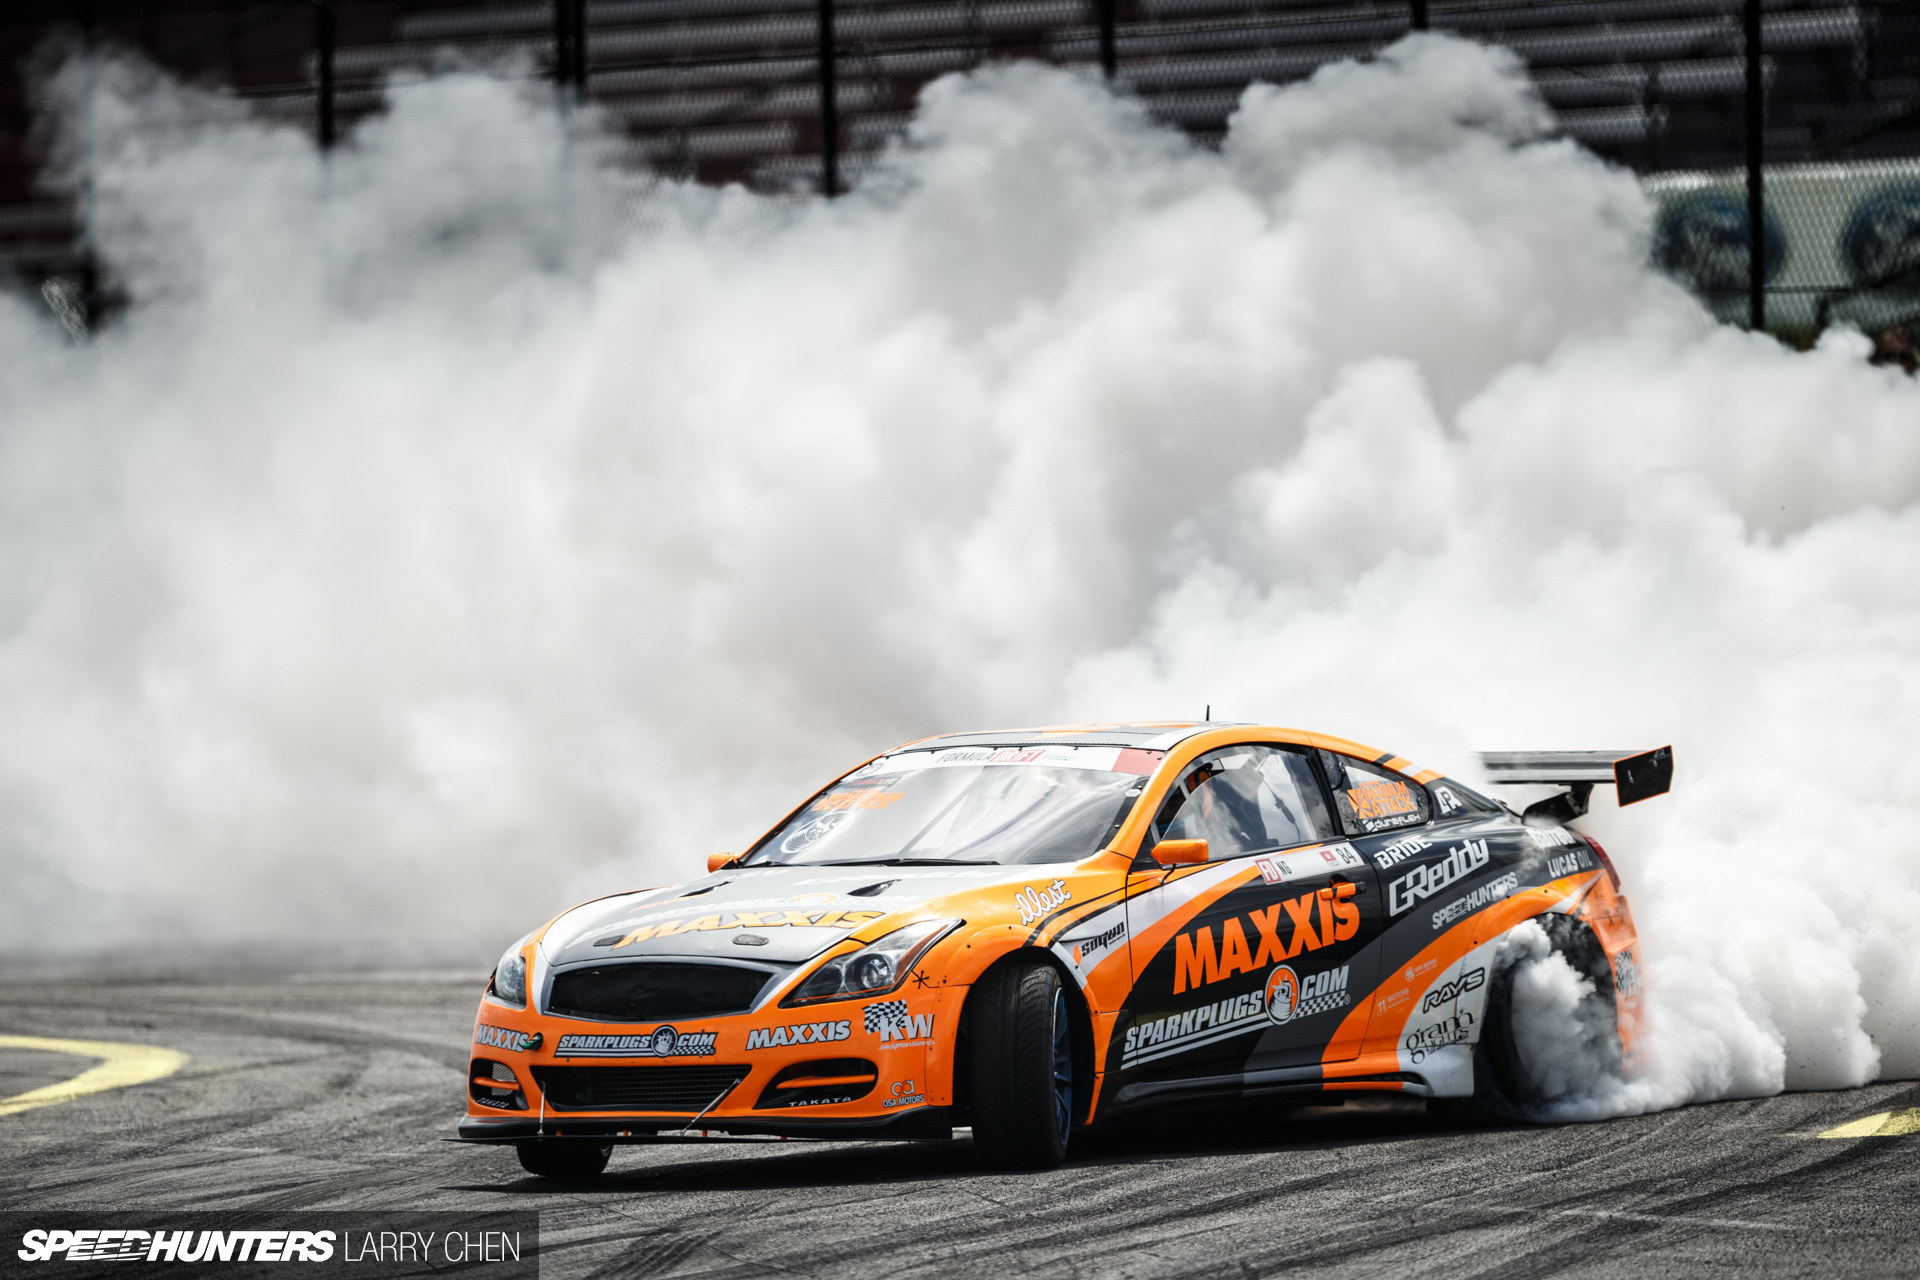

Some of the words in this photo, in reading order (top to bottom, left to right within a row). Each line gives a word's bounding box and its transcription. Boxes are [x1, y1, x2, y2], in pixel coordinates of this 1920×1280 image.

[936, 751, 995, 763] FORMULA
[1370, 795, 1418, 817] ATTACK
[1276, 860, 1292, 876] NG
[1336, 847, 1358, 864] 84
[1374, 835, 1433, 870] BRIDE
[1547, 852, 1579, 878] LUCAS
[1576, 849, 1593, 869] OIL
[1014, 878, 1071, 926] illest
[612, 910, 887, 950] MAXXIS
[1173, 889, 1360, 995] MAXXIS
[1387, 987, 1410, 1002] MOTORS
[1423, 966, 1485, 1014] RAYS
[745, 1020, 852, 1051] MAXXIS
[879, 1013, 935, 1042] KW
[1124, 989, 1264, 1053] SPARKPLUGS
[474, 1024, 530, 1052] MAXXIS
[558, 1035, 651, 1048] SPARKPLUGS
[788, 1097, 852, 1108] TAKATA
[883, 1098, 898, 1108] OSA
[898, 1094, 925, 1106] MOTORS
